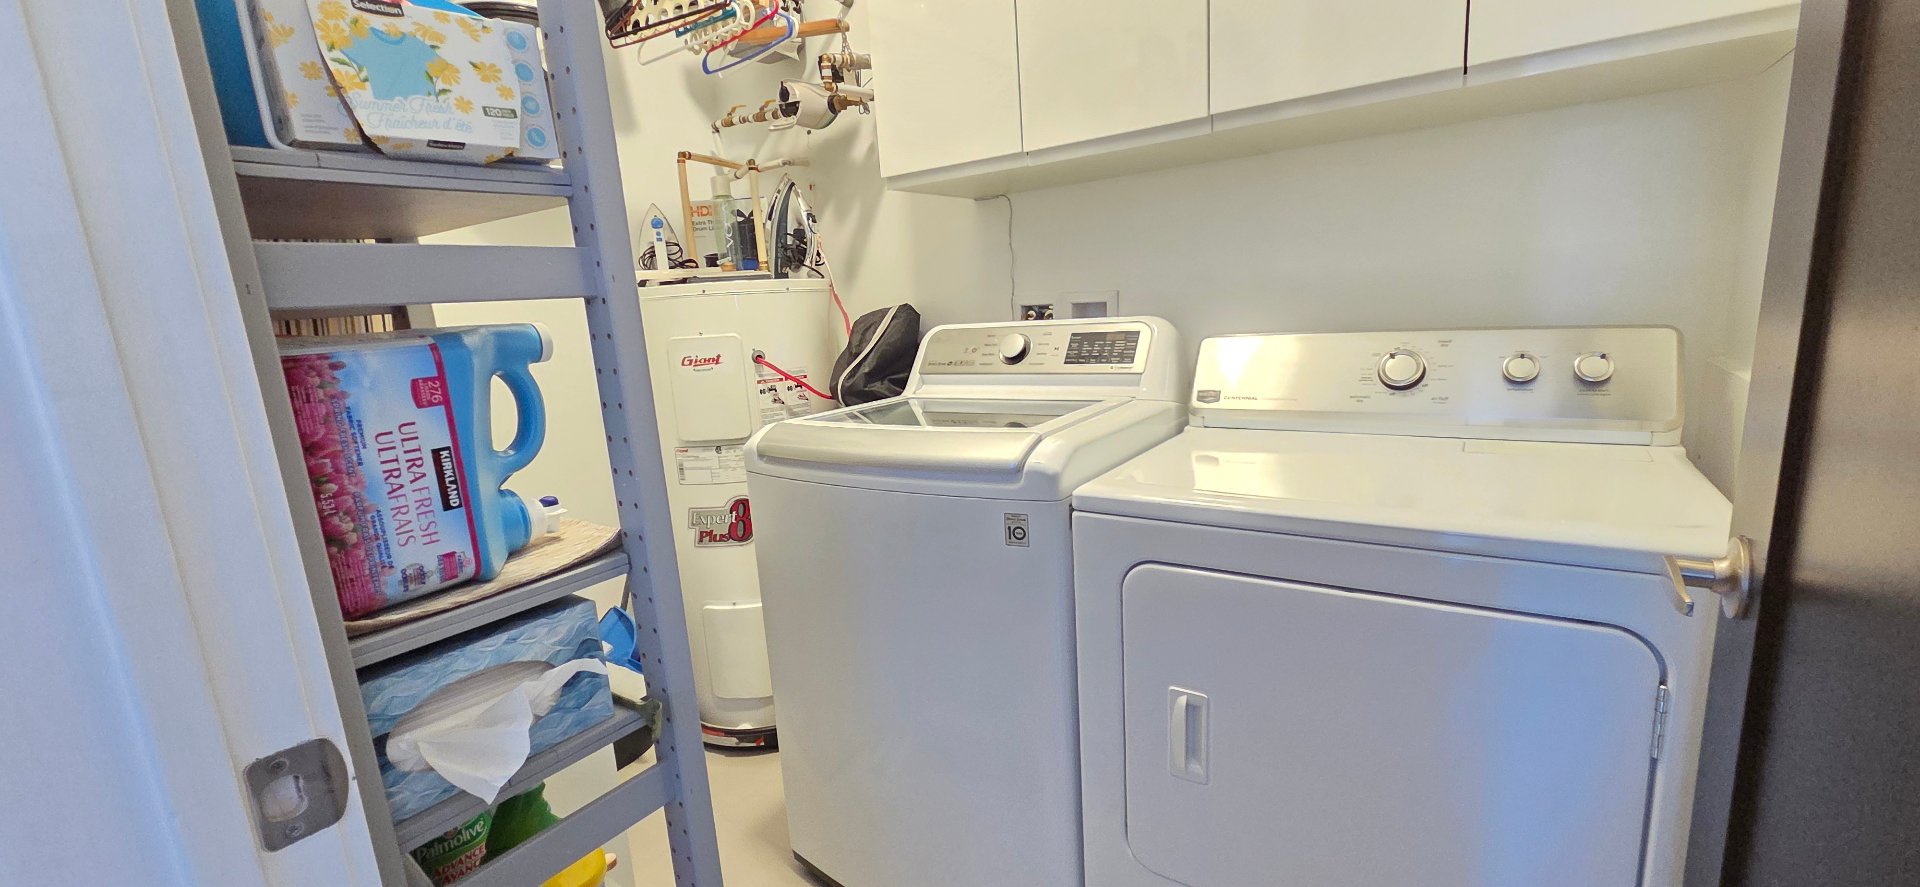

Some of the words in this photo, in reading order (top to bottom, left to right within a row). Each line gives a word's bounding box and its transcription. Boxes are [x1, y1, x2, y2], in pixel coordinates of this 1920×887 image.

[354, 0, 402, 14] Selection
[342, 93, 407, 114] Summer
[408, 94, 455, 114] Fresh
[485, 108, 502, 118] 120
[681, 354, 722, 367] Giant
[428, 379, 443, 403] 276
[345, 406, 355, 431] FABRIC
[351, 432, 364, 467] SOFTENER
[356, 419, 367, 450] PREMIUM
[397, 420, 428, 485] ULTRA
[440, 450, 460, 507] KIRKLAND
[370, 514, 381, 542] GRANDE
[411, 485, 441, 546] FRESH
[692, 511, 736, 529] Expert
[728, 498, 753, 542] 8
[376, 508, 392, 560] ASSOUPLISSEUR
[699, 530, 730, 543] Plus
[415, 818, 485, 863] Palmolive
